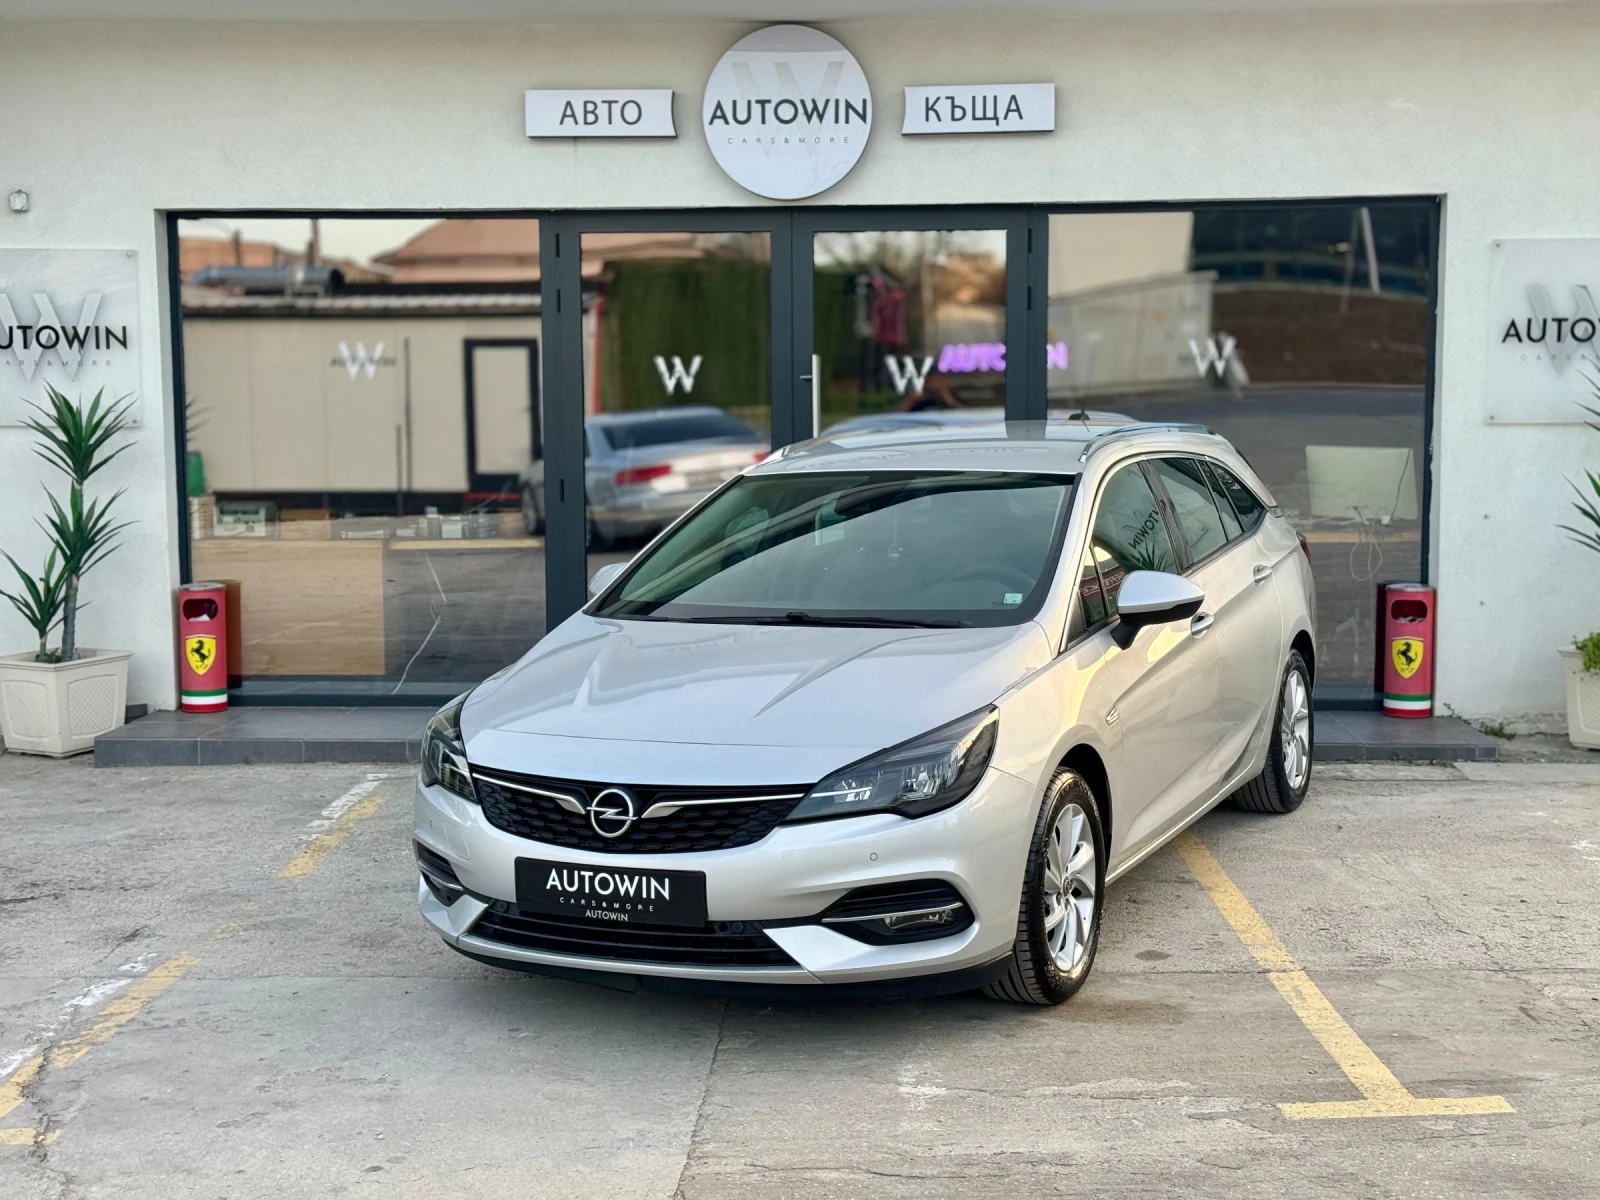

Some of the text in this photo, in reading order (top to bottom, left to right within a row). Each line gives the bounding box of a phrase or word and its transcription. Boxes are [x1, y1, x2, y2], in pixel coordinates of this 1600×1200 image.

[559, 99, 643, 126] АВТО
[708, 98, 867, 125] AUTOWIN
[924, 94, 1024, 126] КЪЩА
[1501, 317, 1600, 344] AUTO
[337, 340, 387, 381] W
[1188, 337, 1237, 378] W
[654, 355, 703, 395] W
[884, 355, 934, 395] W
[546, 867, 670, 900] AUTOWIN
[585, 909, 628, 922] AUTOWIN
